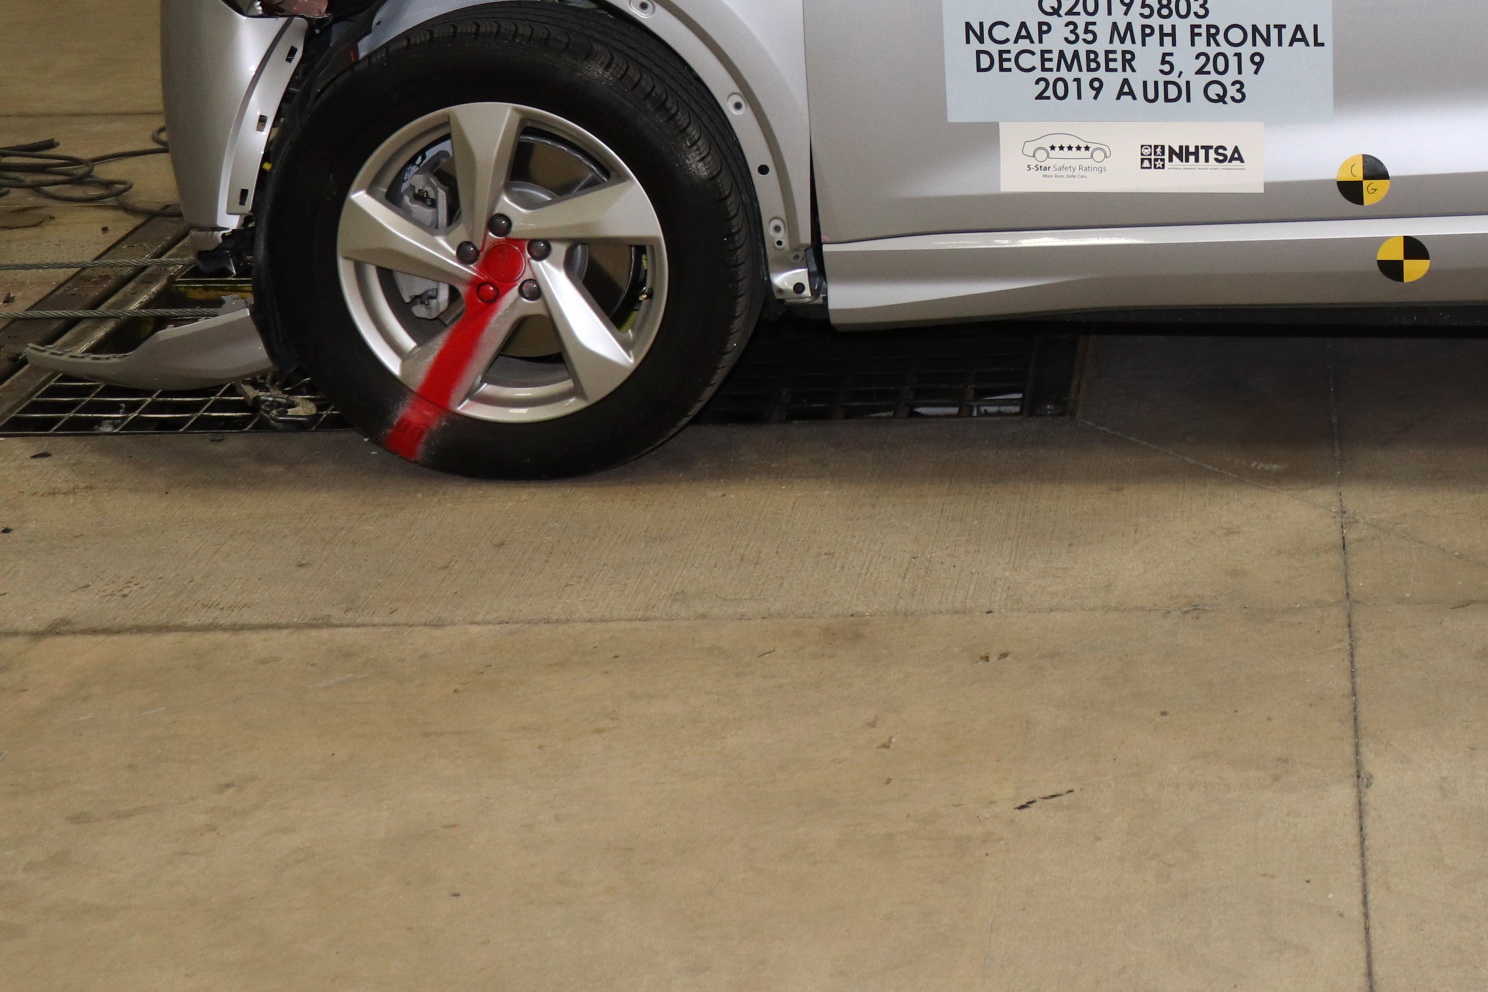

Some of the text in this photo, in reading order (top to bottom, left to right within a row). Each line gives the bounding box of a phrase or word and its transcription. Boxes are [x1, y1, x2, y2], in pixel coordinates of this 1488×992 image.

[964, 20, 1325, 48] NCAP 35 MPH FRONTAL
[975, 48, 1265, 79] DECEMBER 5, 2019
[1034, 76, 1247, 105] 2019 AUDI Q3
[1167, 144, 1245, 164] NHTSA
[1026, 164, 1107, 174] 5-Star Safety Ratings
[1366, 182, 1378, 195] G
